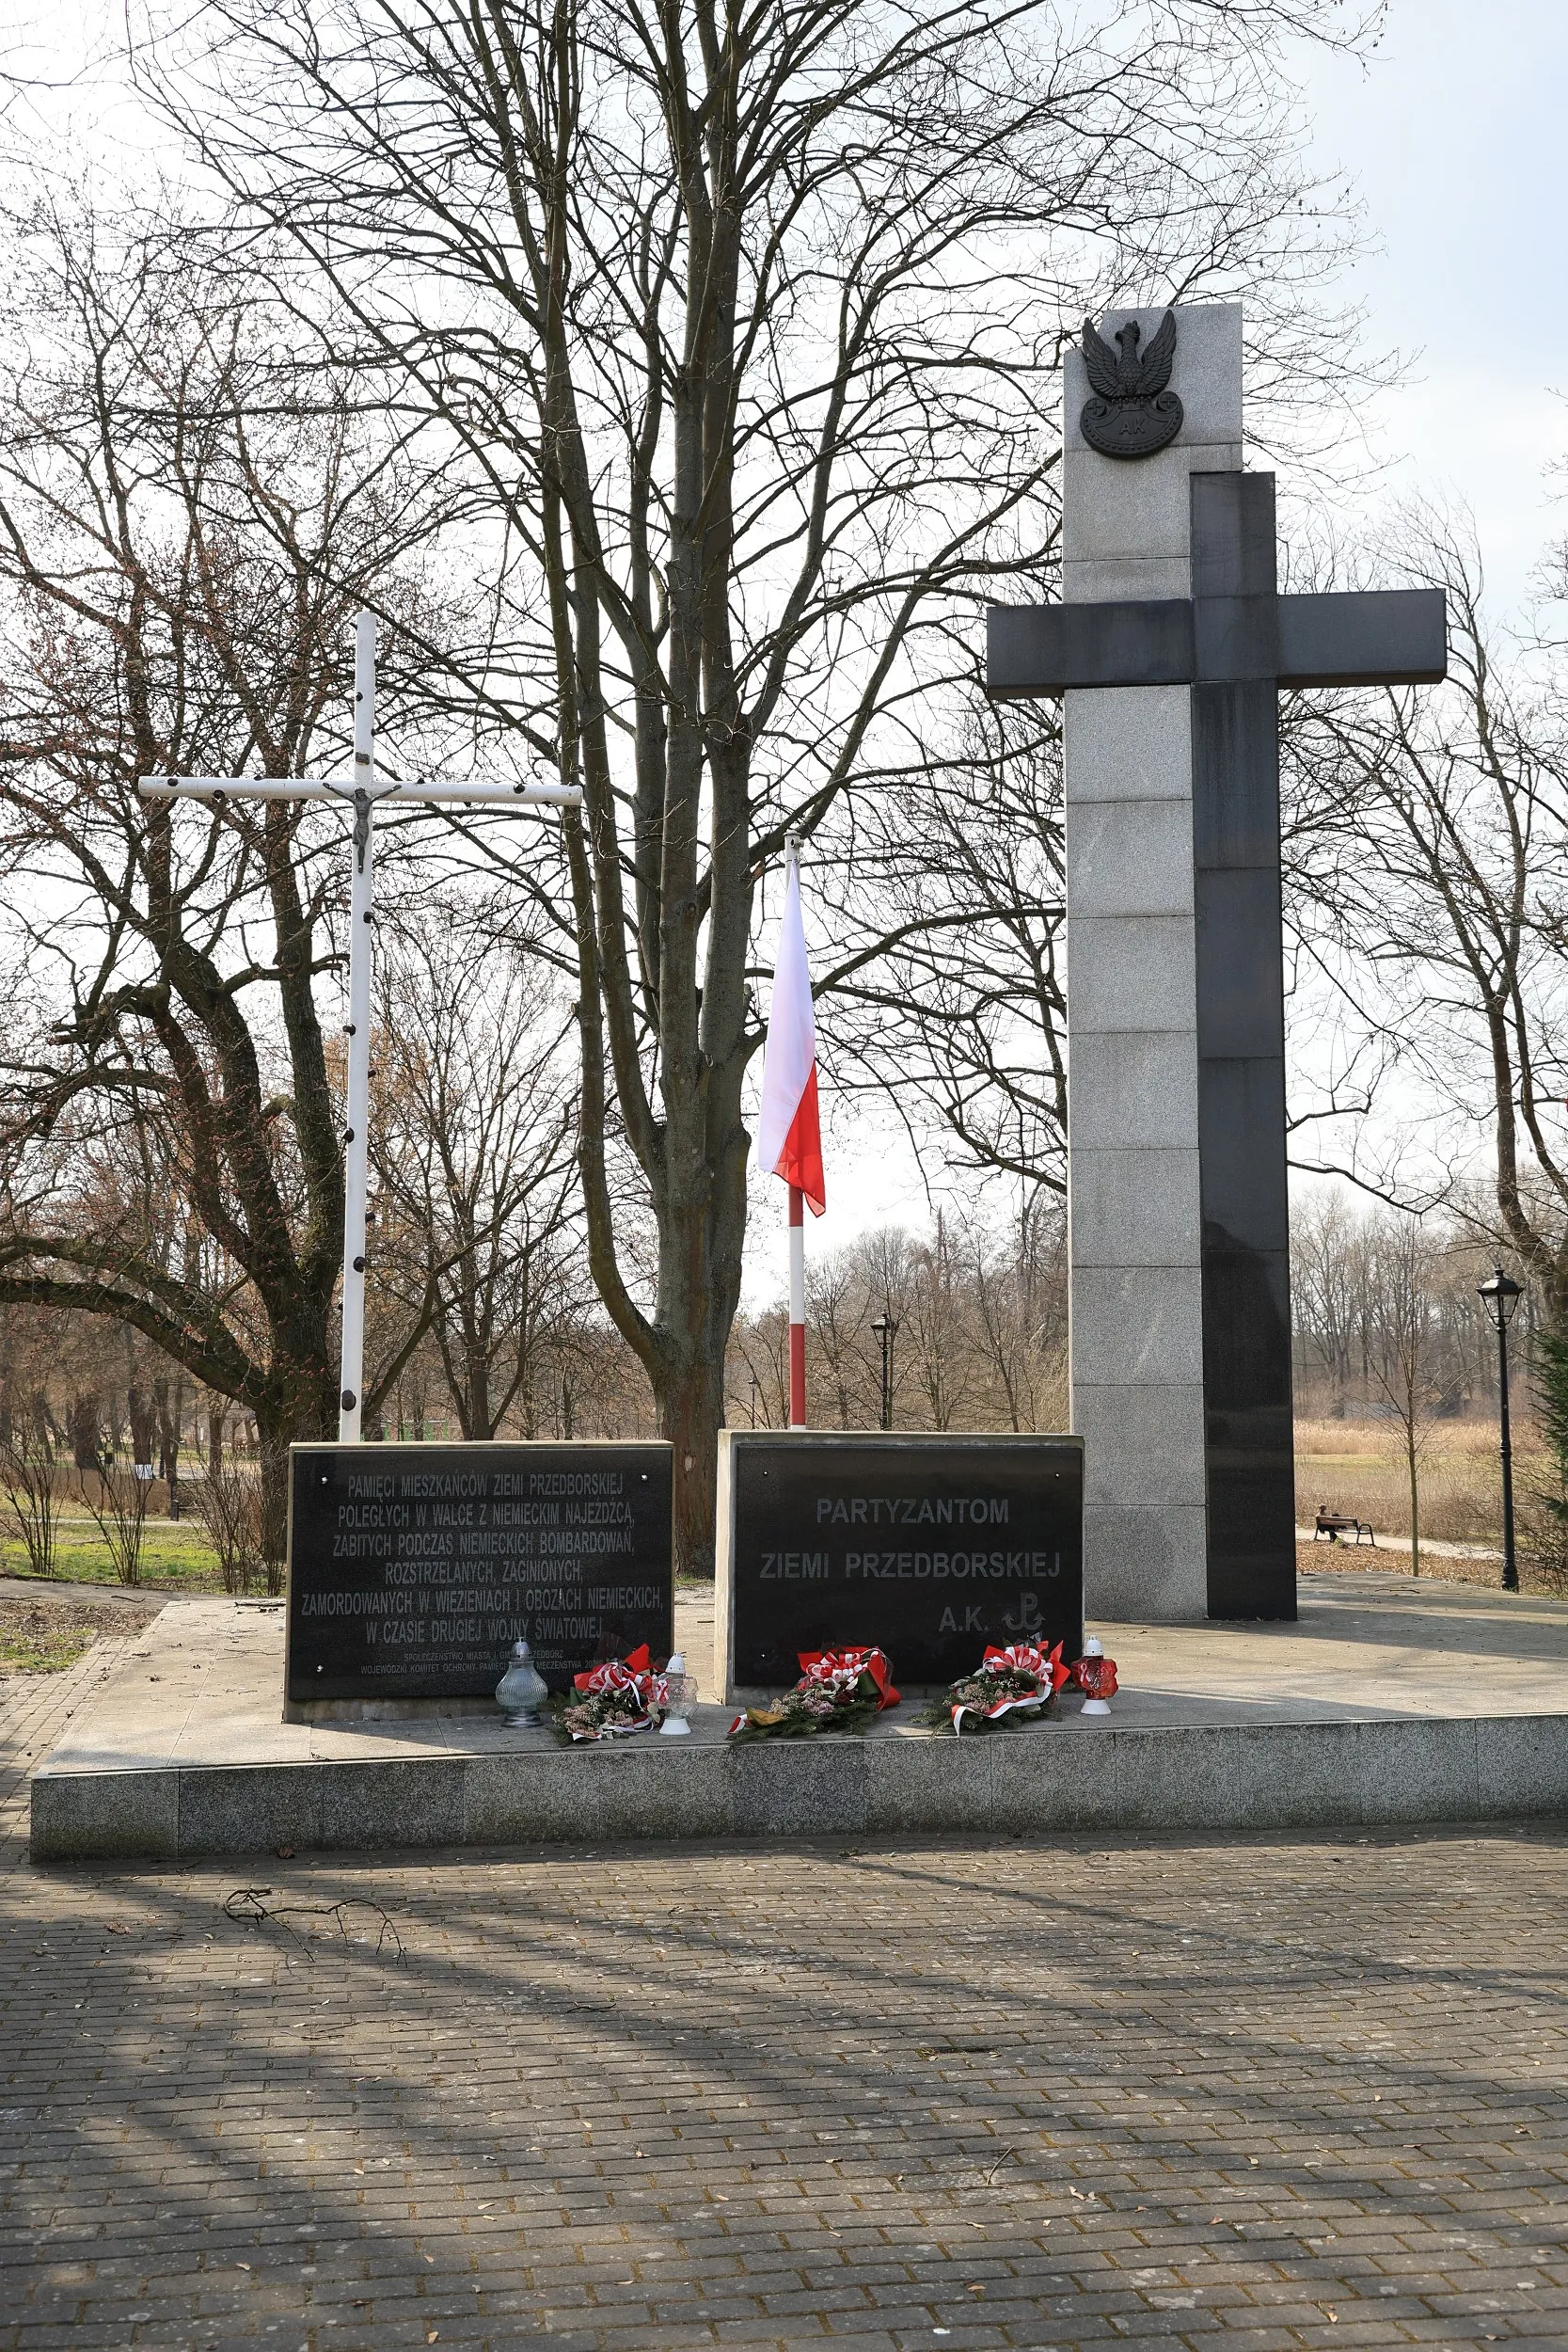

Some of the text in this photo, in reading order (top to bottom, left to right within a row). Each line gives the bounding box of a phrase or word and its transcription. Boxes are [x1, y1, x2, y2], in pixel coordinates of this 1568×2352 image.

[1118, 418, 1146, 436] AK
[348, 1470, 624, 1502] PAMIĘCI MIESZKAŃCÓW ZIEMI PRZEDBORSKIEJ
[338, 1497, 635, 1529] POLEGŁYCH W WALCE Z NIEMIECKIM NAJEŹDŹCĄ,
[816, 1498, 1009, 1524] PARTYZANTOM
[333, 1527, 635, 1557] ZABITYCH PODCZAS NIEMIECKICH BOMBARDOWAŃ,
[385, 1559, 583, 1585] ROZSTRZELANYCH, ZAGINIONYCH,
[759, 1550, 1061, 1579] ZIEMI PRZEDBORSKIEJ
[301, 1590, 412, 1616] ZAMORDOWANYCH
[420, 1590, 430, 1613] W
[436, 1588, 511, 1617] WIĘZIENIACH
[525, 1587, 582, 1612] OBOZACH
[588, 1586, 663, 1613] NIEMIECKICH,
[365, 1613, 602, 1645] W CZASIE DRUGIEJ WOJNY ŚWIATOWEJ
[938, 1606, 989, 1632] A.K.
[410, 1662, 439, 1674] KOMITET
[442, 1662, 476, 1673] OCHRONY
[466, 1651, 490, 1661] MIASTA
